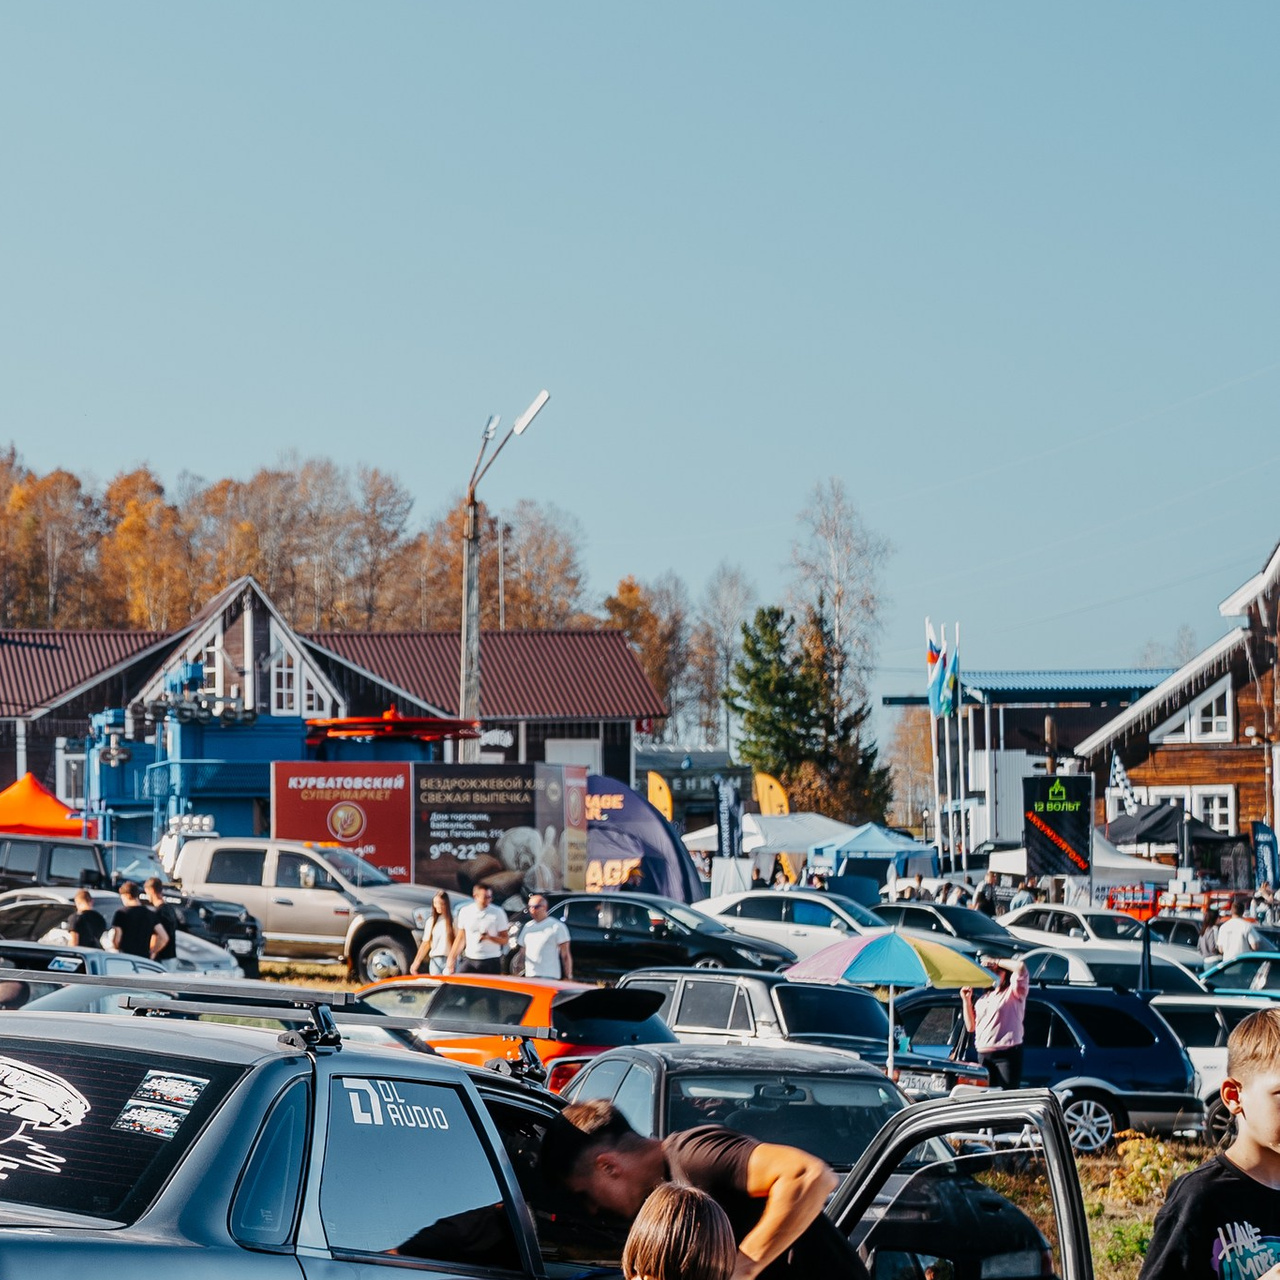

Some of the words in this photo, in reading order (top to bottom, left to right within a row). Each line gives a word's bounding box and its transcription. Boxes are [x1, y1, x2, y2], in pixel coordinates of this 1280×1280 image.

[287, 774, 406, 790] КУРБАТОВСКИЙ
[420, 776, 523, 791] БЕЗДРОЖЖЕВОЙ
[300, 789, 393, 801] СУПЕРМАРКЕТ
[420, 791, 469, 804] СВЕЖАЯ
[473, 791, 532, 804] ВЫПЕЧКА
[1034, 801, 1045, 812] 12
[1046, 801, 1082, 812] ВОЛЬТ
[1024, 810, 1089, 870] АККУМУЛЯТОРЫ
[376, 1080, 405, 1103] DL
[387, 1103, 449, 1130] AUDIO
[1217, 1220, 1267, 1263] HAVE
